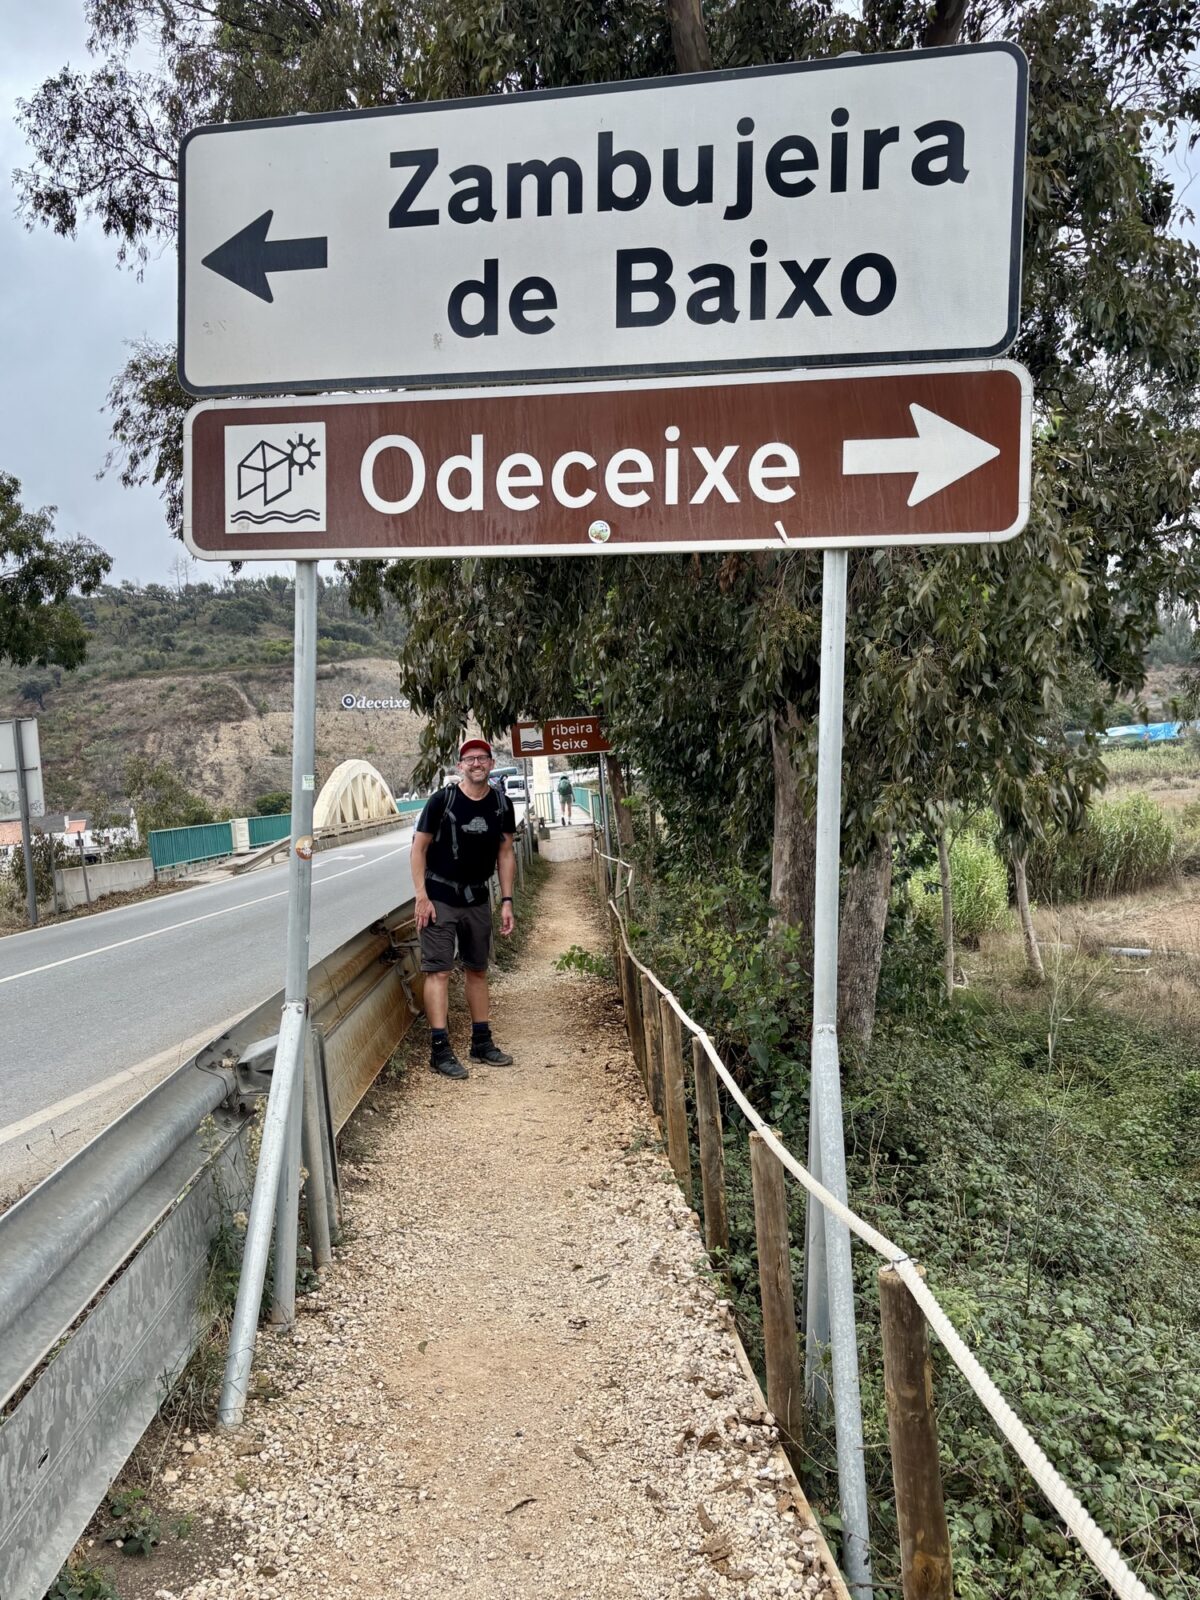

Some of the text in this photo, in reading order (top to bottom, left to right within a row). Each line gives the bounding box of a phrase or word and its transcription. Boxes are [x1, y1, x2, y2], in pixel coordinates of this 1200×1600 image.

[389, 107, 970, 229] Zambujeira
[448, 239, 897, 339] de Baixo
[360, 426, 801, 515] Odeceixe
[341, 693, 410, 709] Odeceixe
[551, 723, 593, 736] ribeira
[552, 738, 588, 751] Seixe
